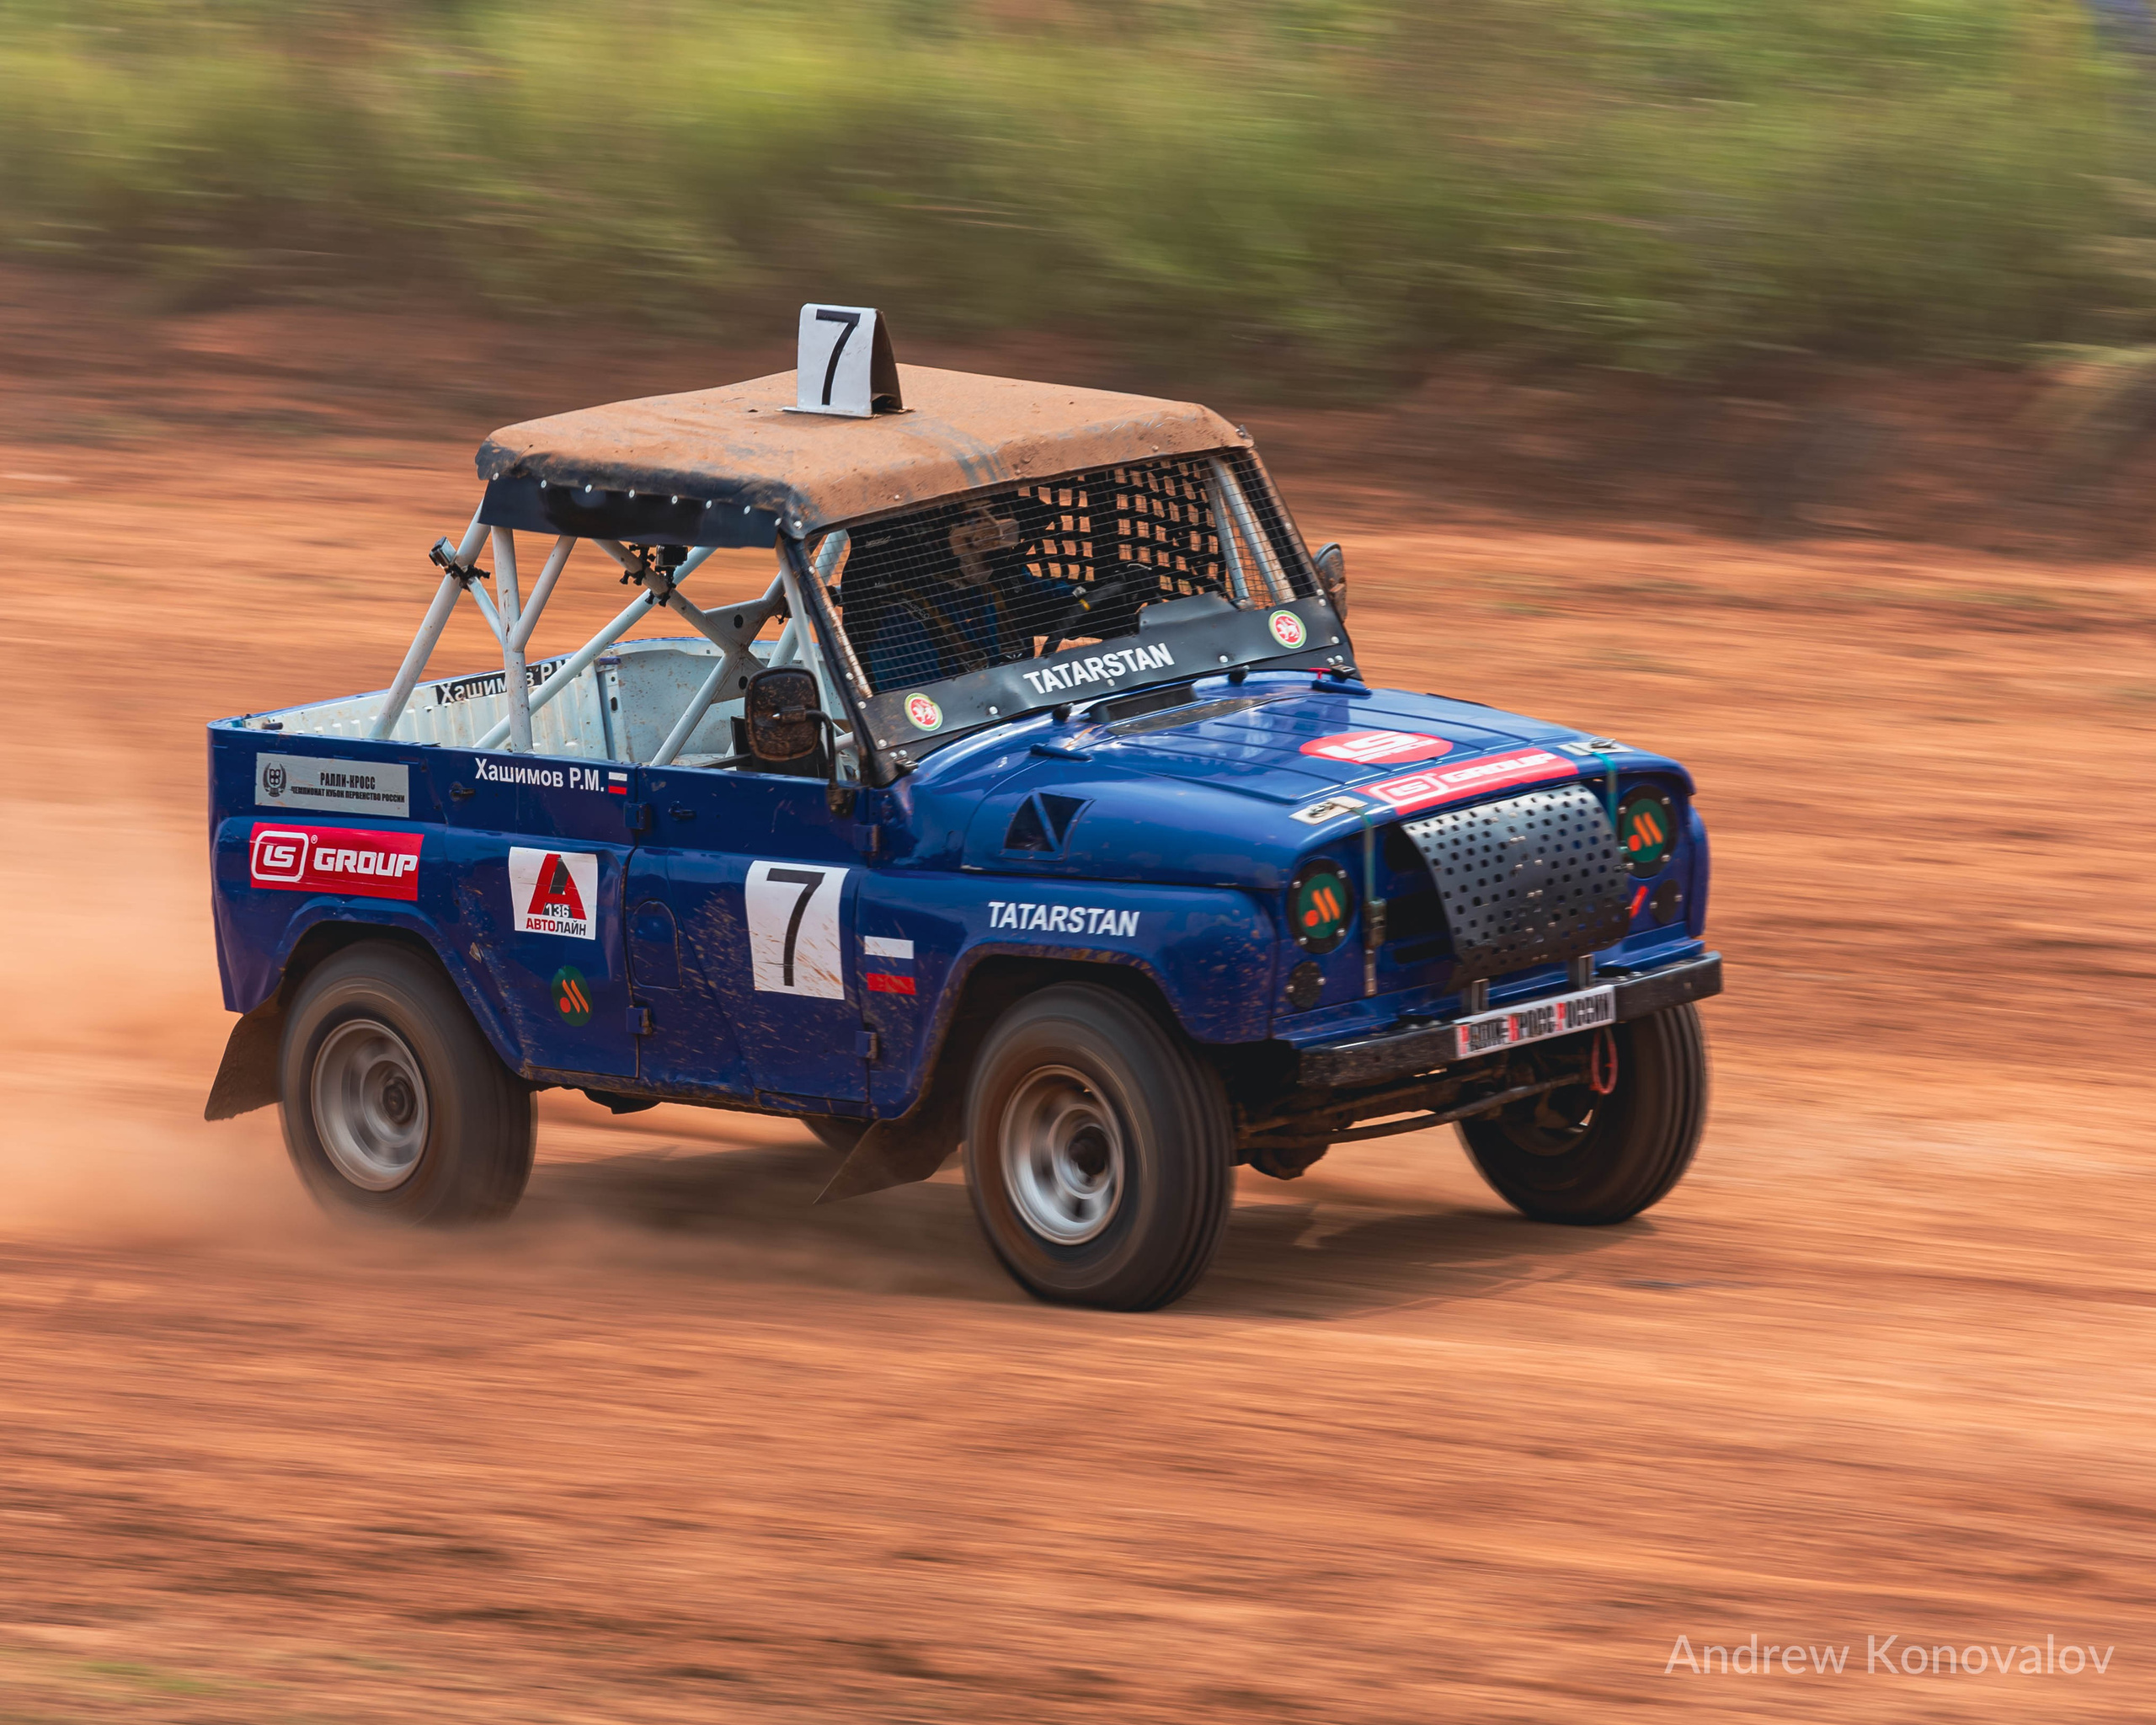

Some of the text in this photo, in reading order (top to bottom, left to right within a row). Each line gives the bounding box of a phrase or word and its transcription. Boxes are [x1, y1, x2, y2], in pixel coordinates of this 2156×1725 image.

[815, 308, 861, 406] 7
[1022, 642, 1175, 695] TATARSTAN
[440, 671, 534, 704] Хашимв
[320, 772, 376, 791] РАЛЛИ-КРОСС
[474, 757, 606, 793] Хашимов Р.М.
[1437, 752, 1560, 783] GROUP
[325, 788, 344, 798] КУБОК
[345, 790, 382, 802] ПЕРВЕНСТВО
[382, 794, 405, 804] РОССИИ
[313, 846, 419, 878] GROUP
[545, 903, 569, 918] 136
[988, 900, 1141, 937] TATARSTAN
[526, 917, 586, 937] АВТОЛАЙН
[766, 868, 826, 987] 7
